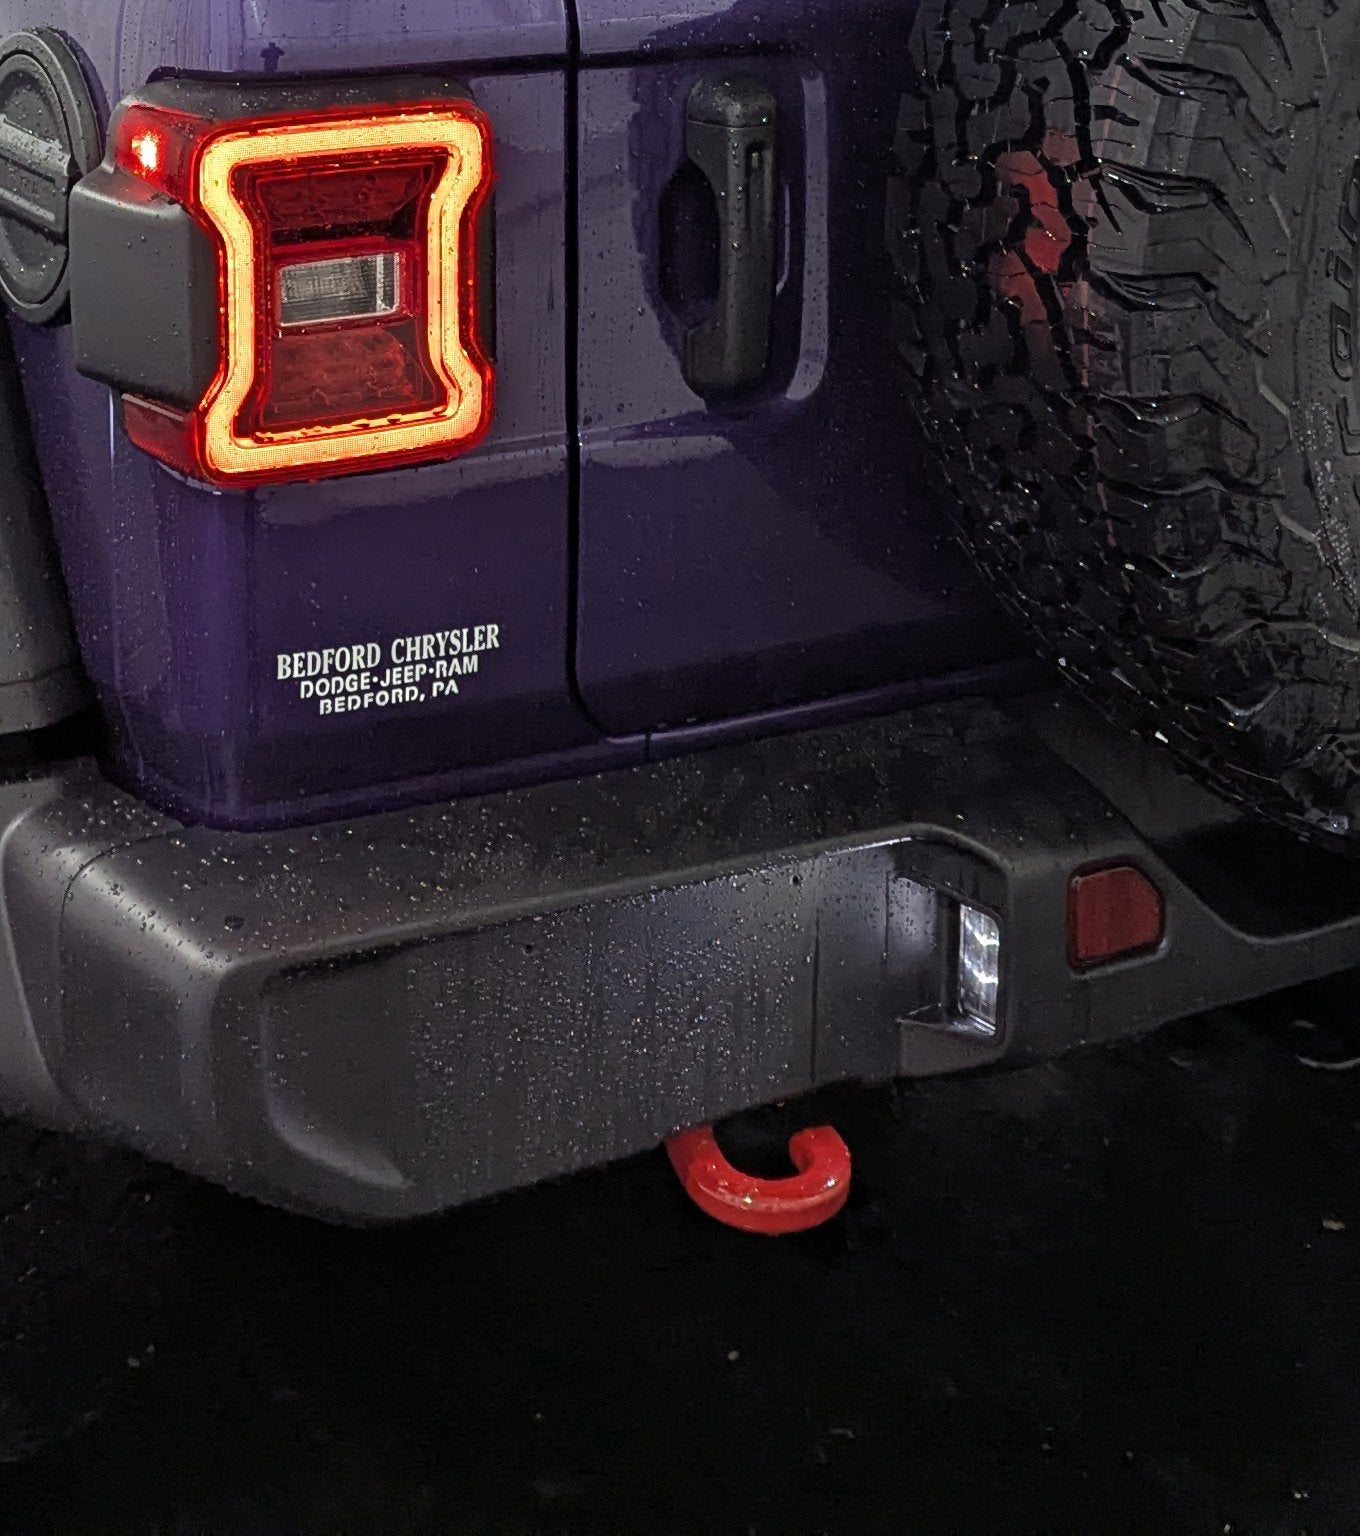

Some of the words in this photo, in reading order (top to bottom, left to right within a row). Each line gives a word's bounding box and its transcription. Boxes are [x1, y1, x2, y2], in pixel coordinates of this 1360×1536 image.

[277, 643, 381, 680] BEDFORD
[391, 624, 500, 664] CHRYSLER
[319, 686, 426, 716] BEDFORD,
[432, 679, 459, 698] PA
